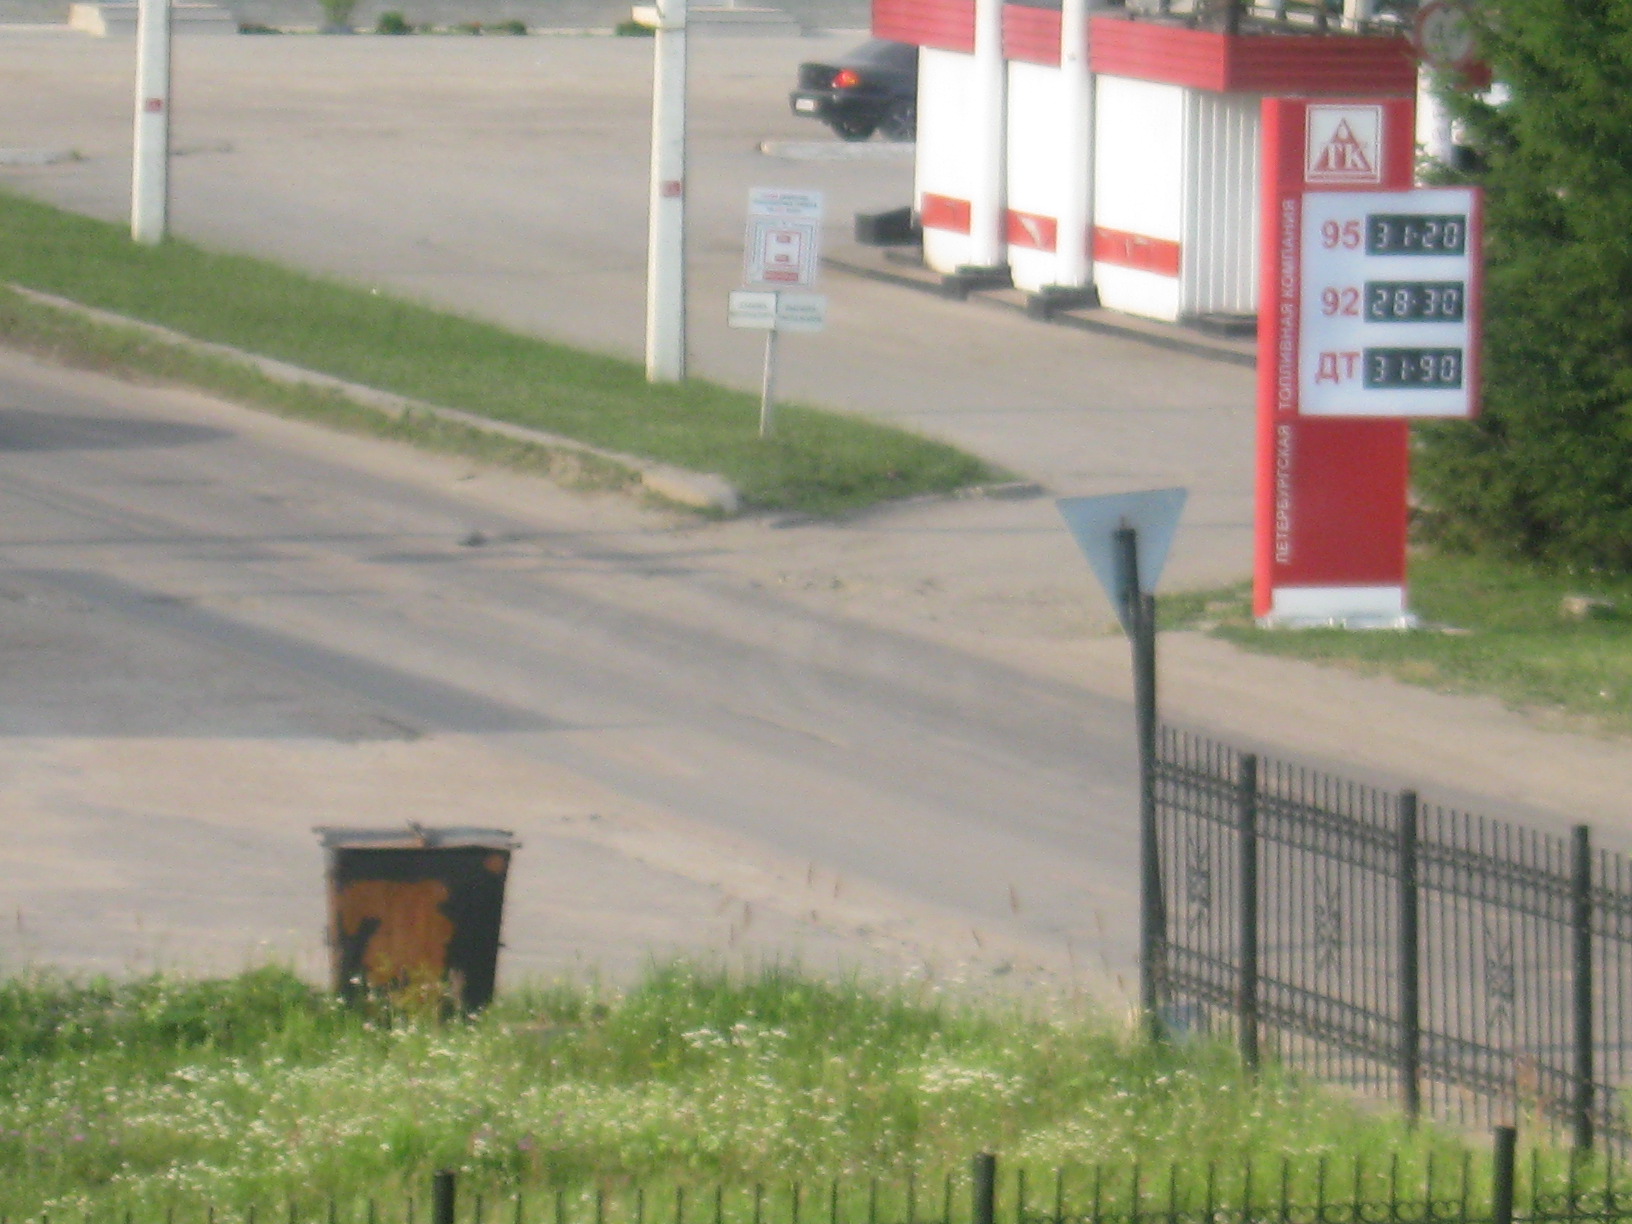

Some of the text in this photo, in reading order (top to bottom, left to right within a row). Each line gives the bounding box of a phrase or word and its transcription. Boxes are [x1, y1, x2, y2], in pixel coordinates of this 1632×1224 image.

[1281, 198, 1296, 299] КОМПАНИЯ
[1320, 219, 1362, 250] 95
[1320, 286, 1361, 317] 92
[1278, 302, 1294, 411] ТОПЛИВНАЯ
[1315, 351, 1361, 385] ДТ
